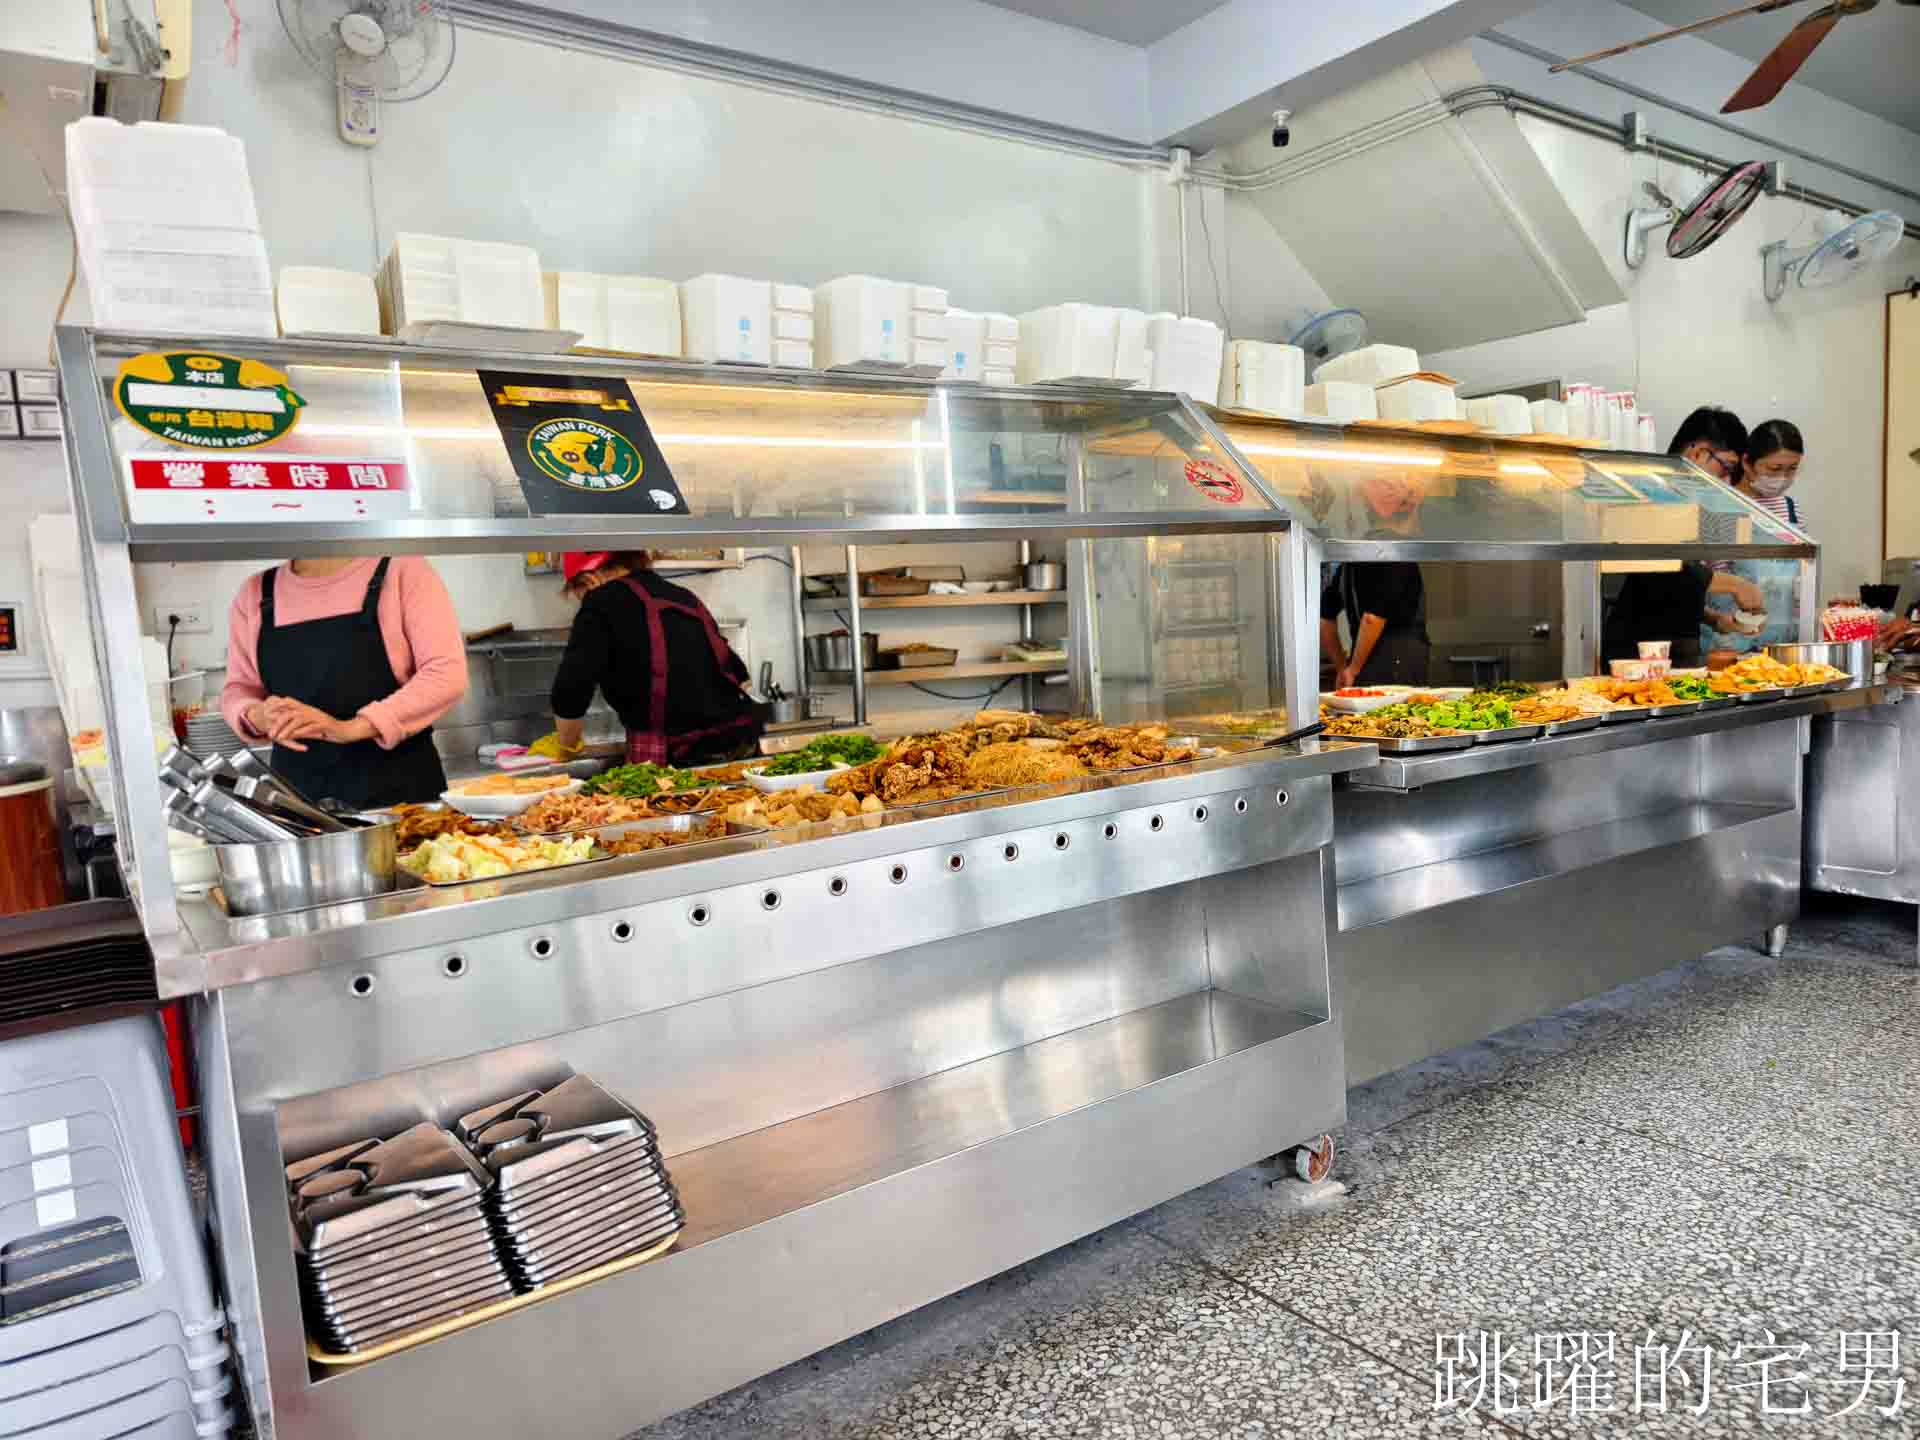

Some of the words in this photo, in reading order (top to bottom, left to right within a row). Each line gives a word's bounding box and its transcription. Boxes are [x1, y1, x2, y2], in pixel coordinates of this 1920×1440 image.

[163, 427, 223, 447] TAIWAN
[225, 432, 269, 447] PORK
[535, 422, 576, 441] TAIWAN
[578, 422, 615, 440] PORK
[162, 462, 389, 488] 營業時間
